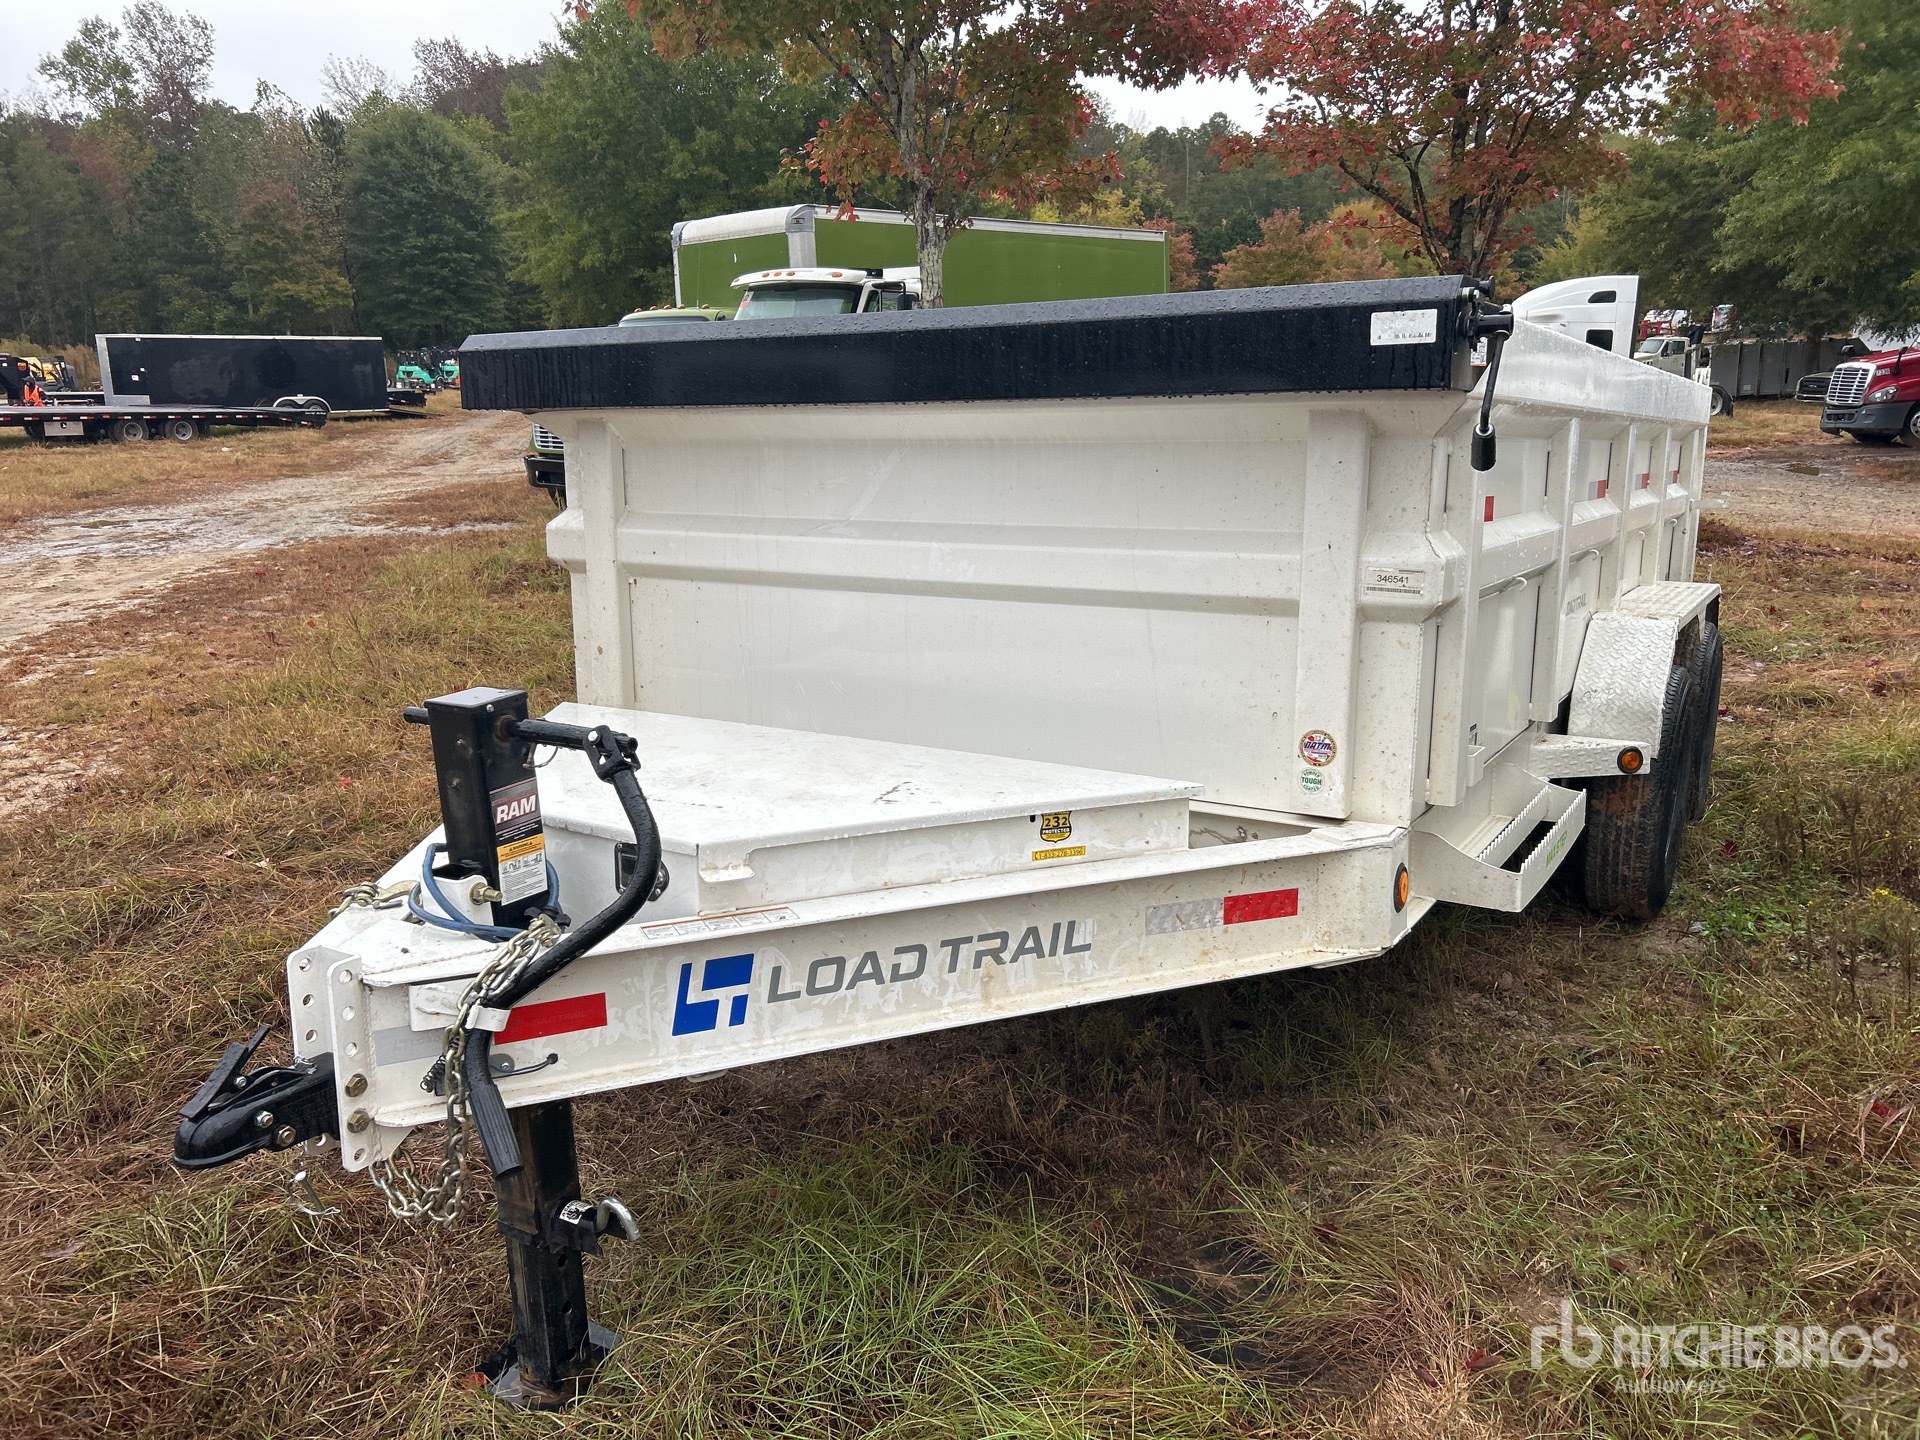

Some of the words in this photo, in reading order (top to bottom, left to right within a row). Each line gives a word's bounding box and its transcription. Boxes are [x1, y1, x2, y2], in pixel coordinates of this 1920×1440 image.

[1376, 574, 1409, 584] 346541
[1301, 776, 1322, 785] TOUGH
[496, 794, 537, 824] RAM
[1044, 816, 1068, 828] 232
[1042, 827, 1070, 835] PROTECTED
